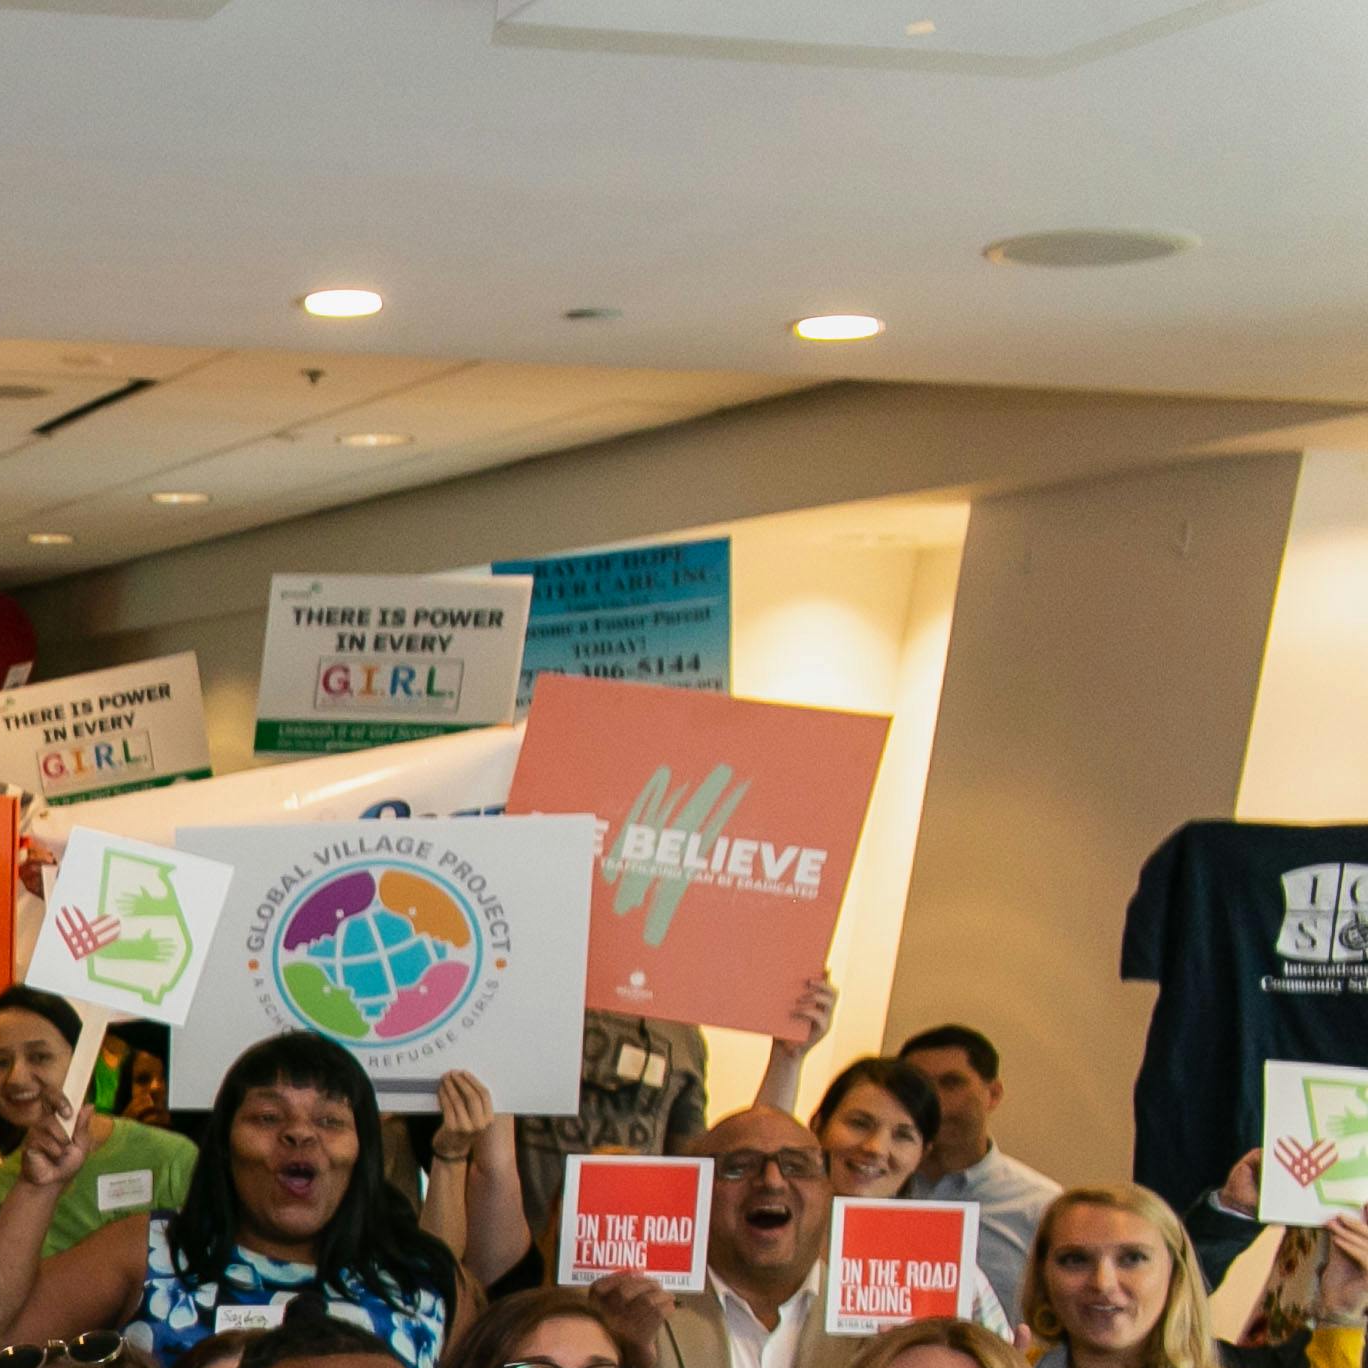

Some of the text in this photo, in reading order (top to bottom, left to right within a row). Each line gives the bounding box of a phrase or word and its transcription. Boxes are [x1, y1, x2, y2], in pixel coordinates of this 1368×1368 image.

[293, 605, 504, 629] THERE IS POWER
[336, 632, 454, 654] IN EVERY
[3, 682, 171, 731] THERE IS POWER
[43, 712, 135, 745] IN EVERY
[621, 822, 829, 886] BELIEVE
[246, 834, 513, 954] GLOBAL VILLAGE PROJECT
[367, 977, 501, 1069] REFUGEE GIRLS
[576, 1213, 693, 1244] ON THE ROAD
[575, 1240, 648, 1269] LENDING
[841, 1257, 958, 1290] ON THE ROAD
[839, 1285, 913, 1314] LENDING
